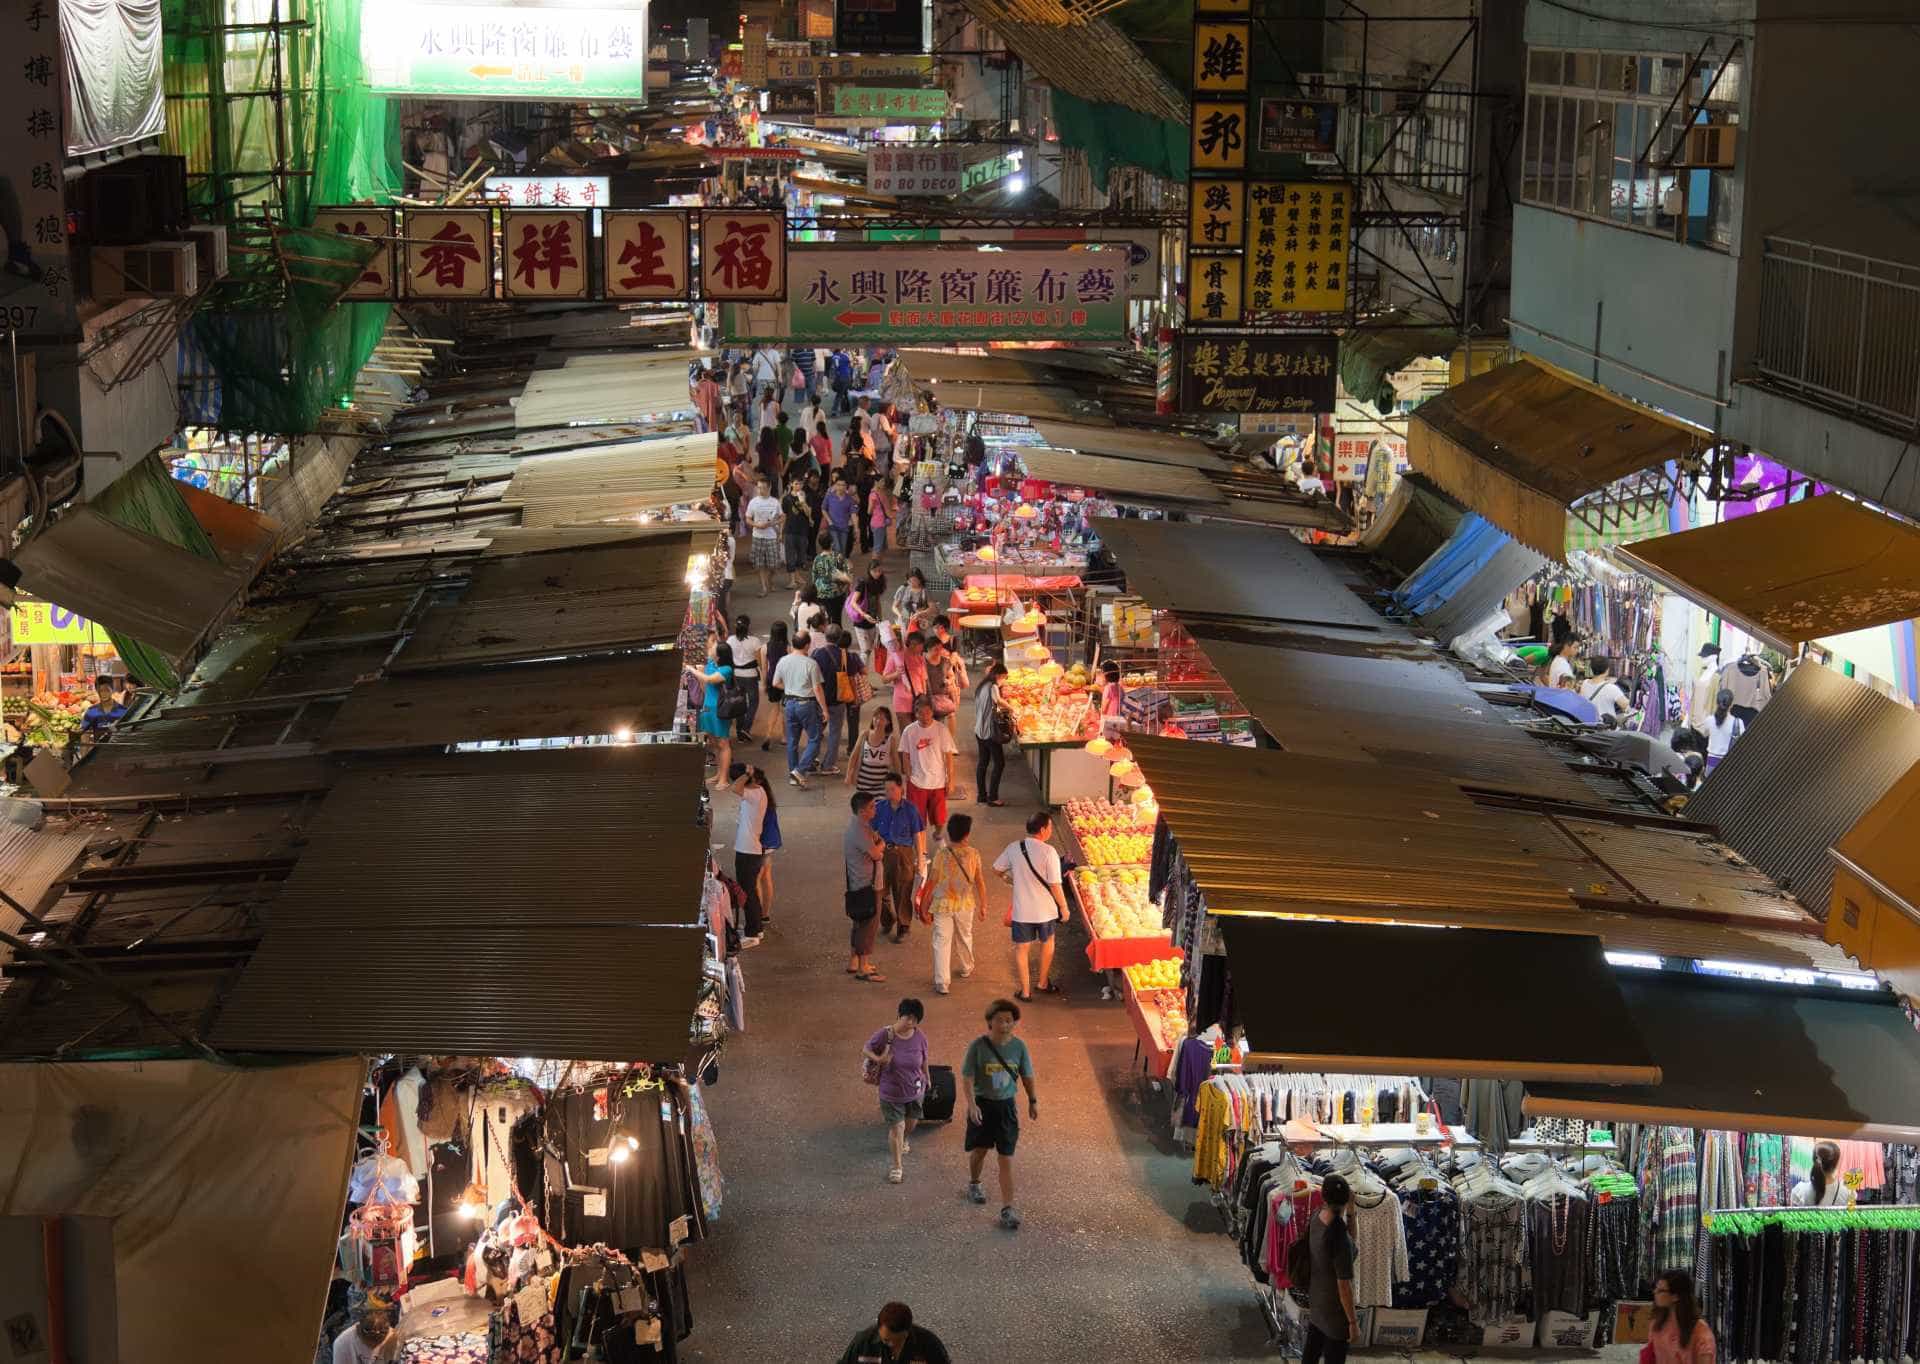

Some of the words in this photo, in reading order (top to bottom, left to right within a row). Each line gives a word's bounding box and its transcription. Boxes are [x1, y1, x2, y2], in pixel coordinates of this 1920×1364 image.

[921, 179, 957, 190] DECO
[803, 267, 1116, 307] 永興隆窗簾布藝
